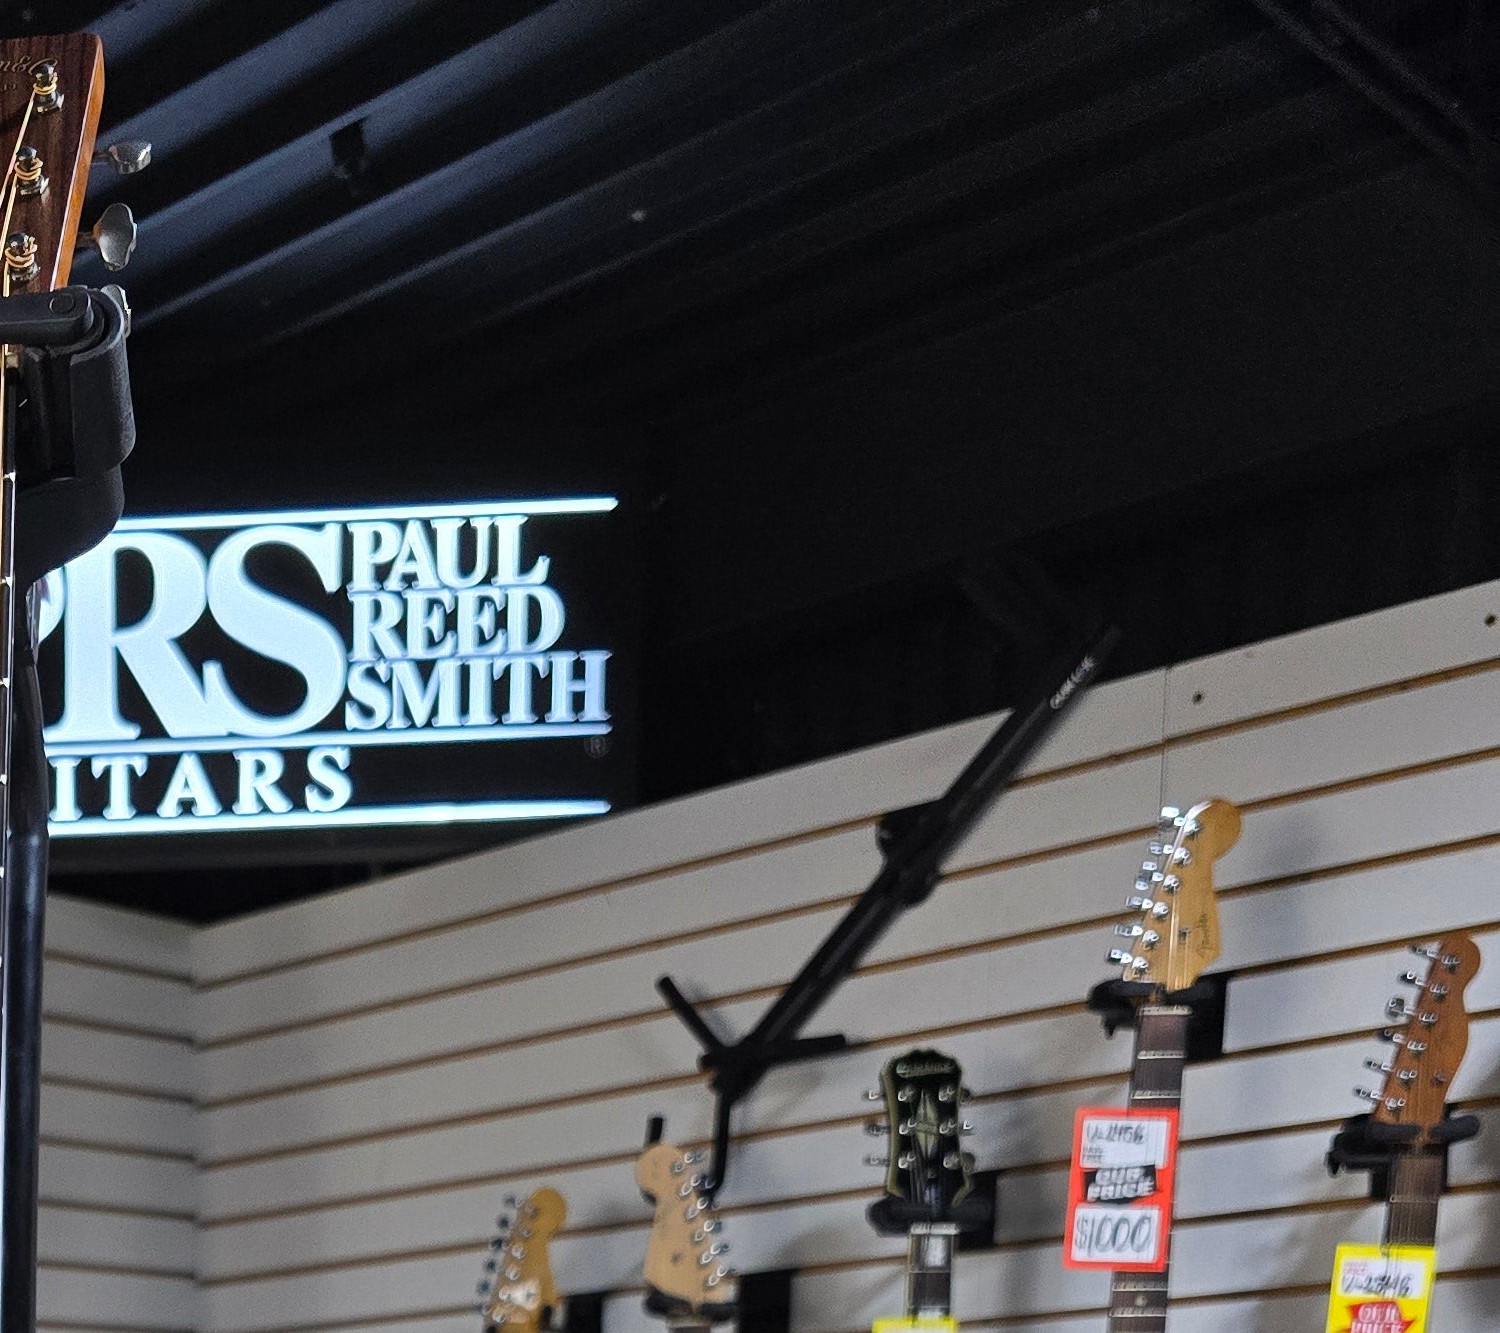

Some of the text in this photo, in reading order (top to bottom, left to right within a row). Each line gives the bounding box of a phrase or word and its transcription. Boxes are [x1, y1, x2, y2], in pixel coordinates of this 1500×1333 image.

[346, 514, 550, 591] PAUL
[346, 584, 566, 662] REED
[344, 649, 614, 732] SMITH
[48, 746, 352, 822] ITARS
[1086, 1180, 1156, 1202] PRICE
[1074, 1214, 1153, 1257] $1000
